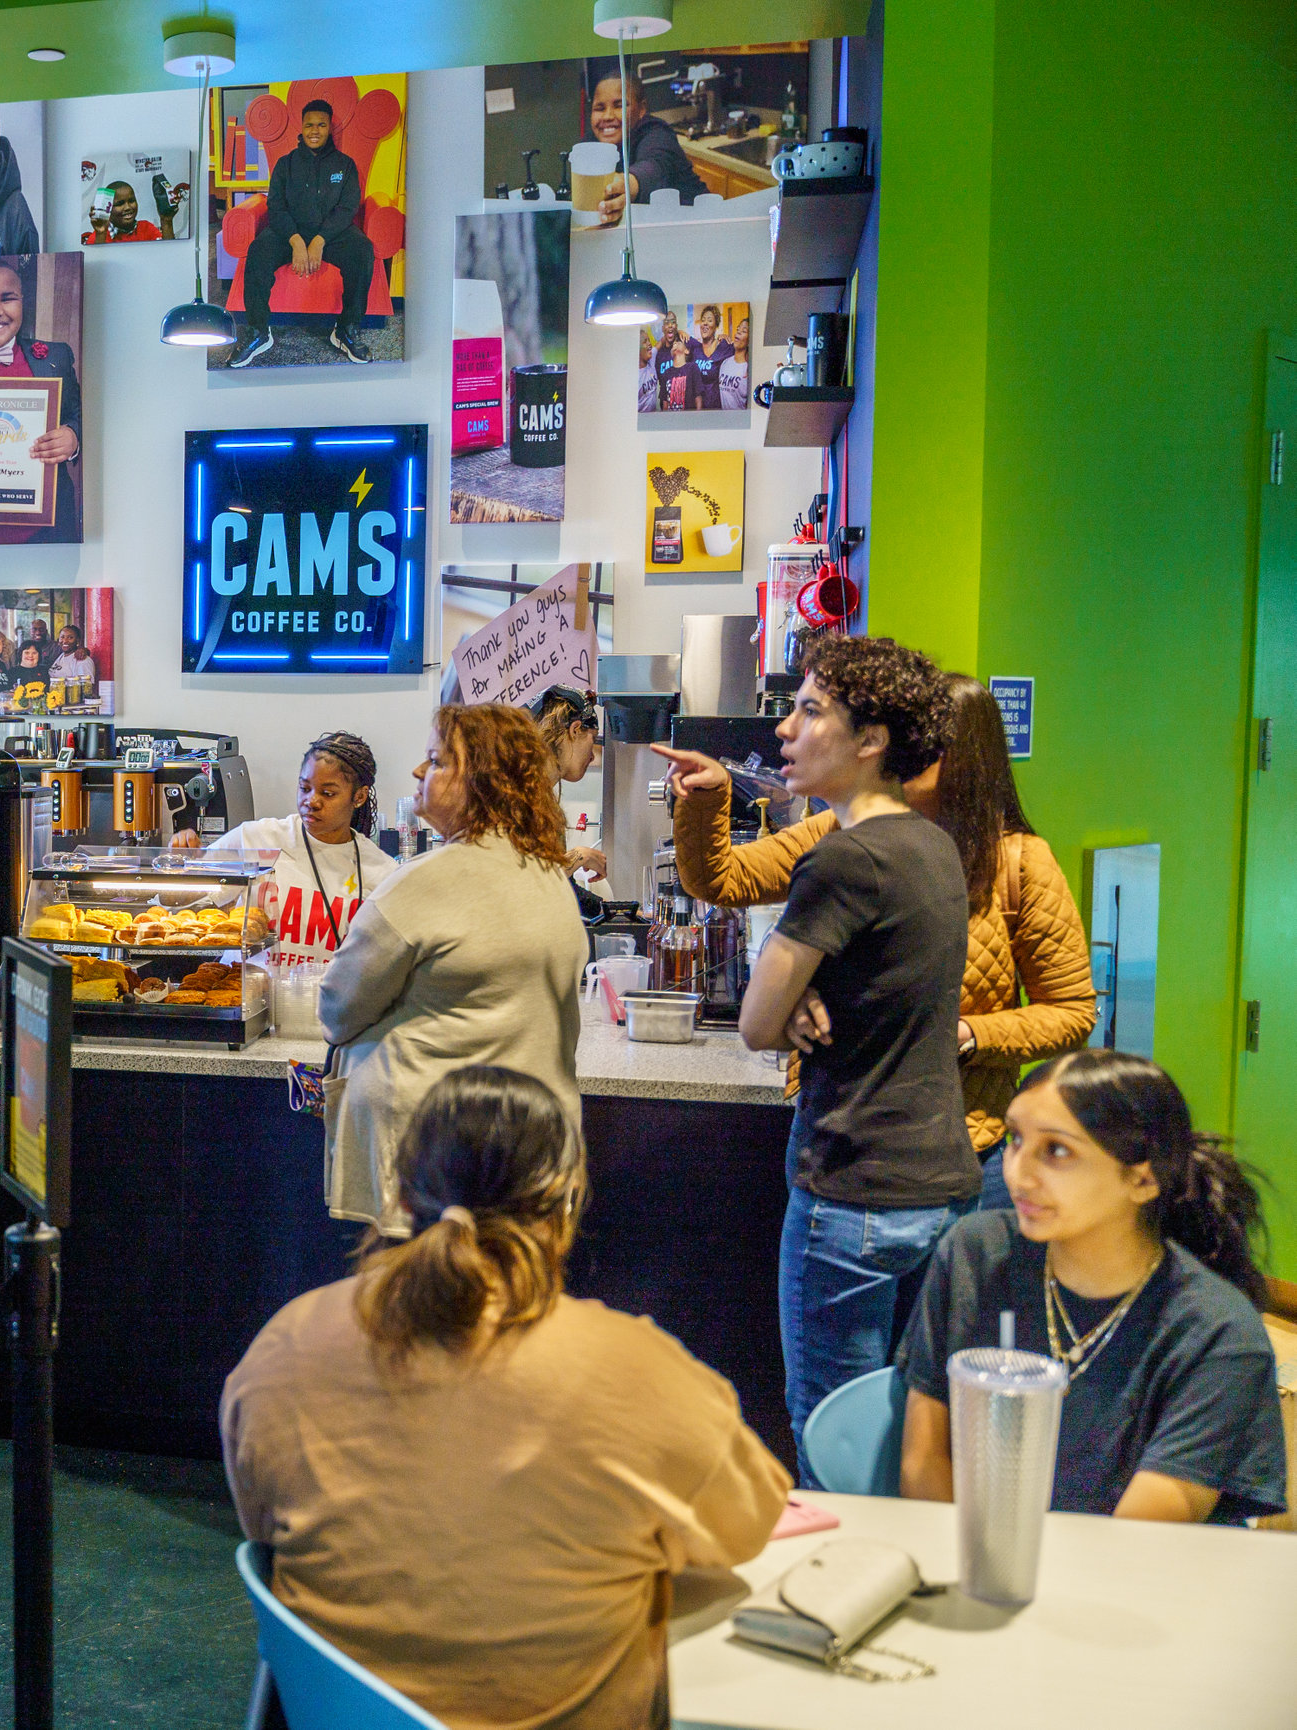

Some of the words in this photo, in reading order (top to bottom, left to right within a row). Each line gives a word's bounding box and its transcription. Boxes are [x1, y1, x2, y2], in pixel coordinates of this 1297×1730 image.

[468, 420, 489, 433] CAMS
[519, 403, 564, 431] CAMS
[523, 434, 546, 442] COFFEE
[549, 433, 559, 441] CO.
[211, 511, 397, 596] CAMS
[232, 610, 320, 633] COFFEE
[335, 610, 372, 633] CO.
[462, 632, 503, 670] Thank
[508, 609, 530, 647] you
[536, 584, 567, 624] guys
[471, 677, 490, 698] for
[497, 630, 547, 678] MAKING
[559, 614, 570, 632] A
[493, 643, 567, 704] FERENCE!
[993, 688, 1019, 697] OCCUPANCY
[1020, 688, 1027, 697] BY
